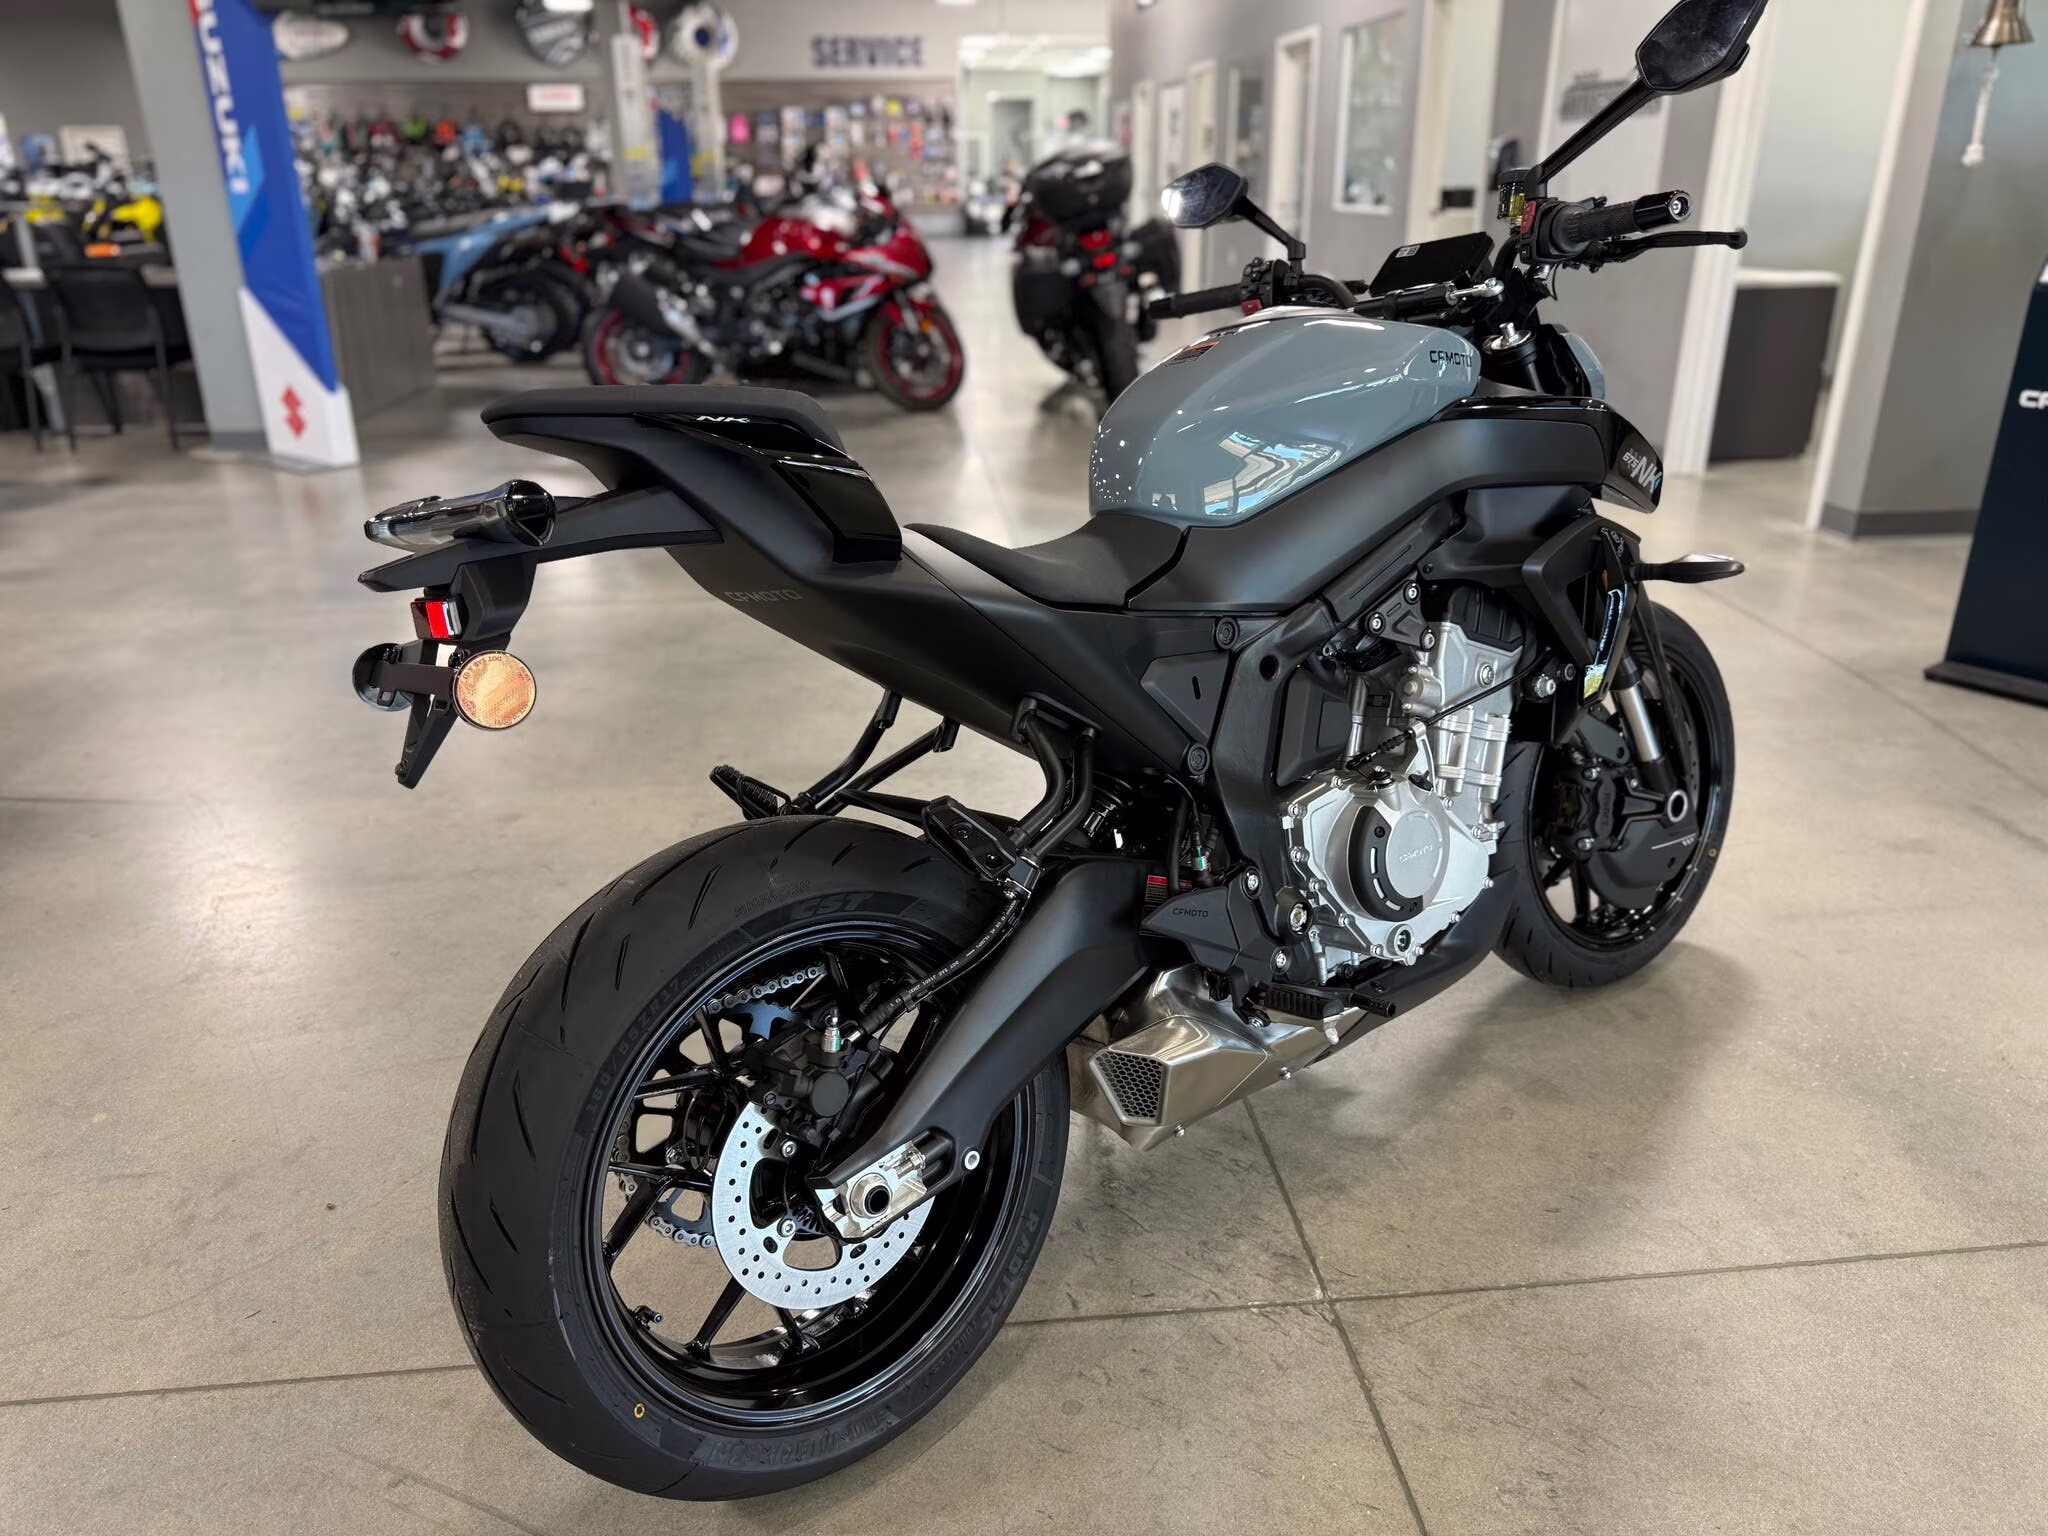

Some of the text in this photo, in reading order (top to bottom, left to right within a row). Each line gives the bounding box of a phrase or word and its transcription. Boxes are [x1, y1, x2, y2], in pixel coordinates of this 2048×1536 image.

[811, 34, 923, 68] SERVICE
[196, 0, 250, 195] UZUKI
[1622, 451, 1662, 494] 675 NK
[723, 588, 804, 602] CFMOTO
[1172, 907, 1209, 918] CFMOTO
